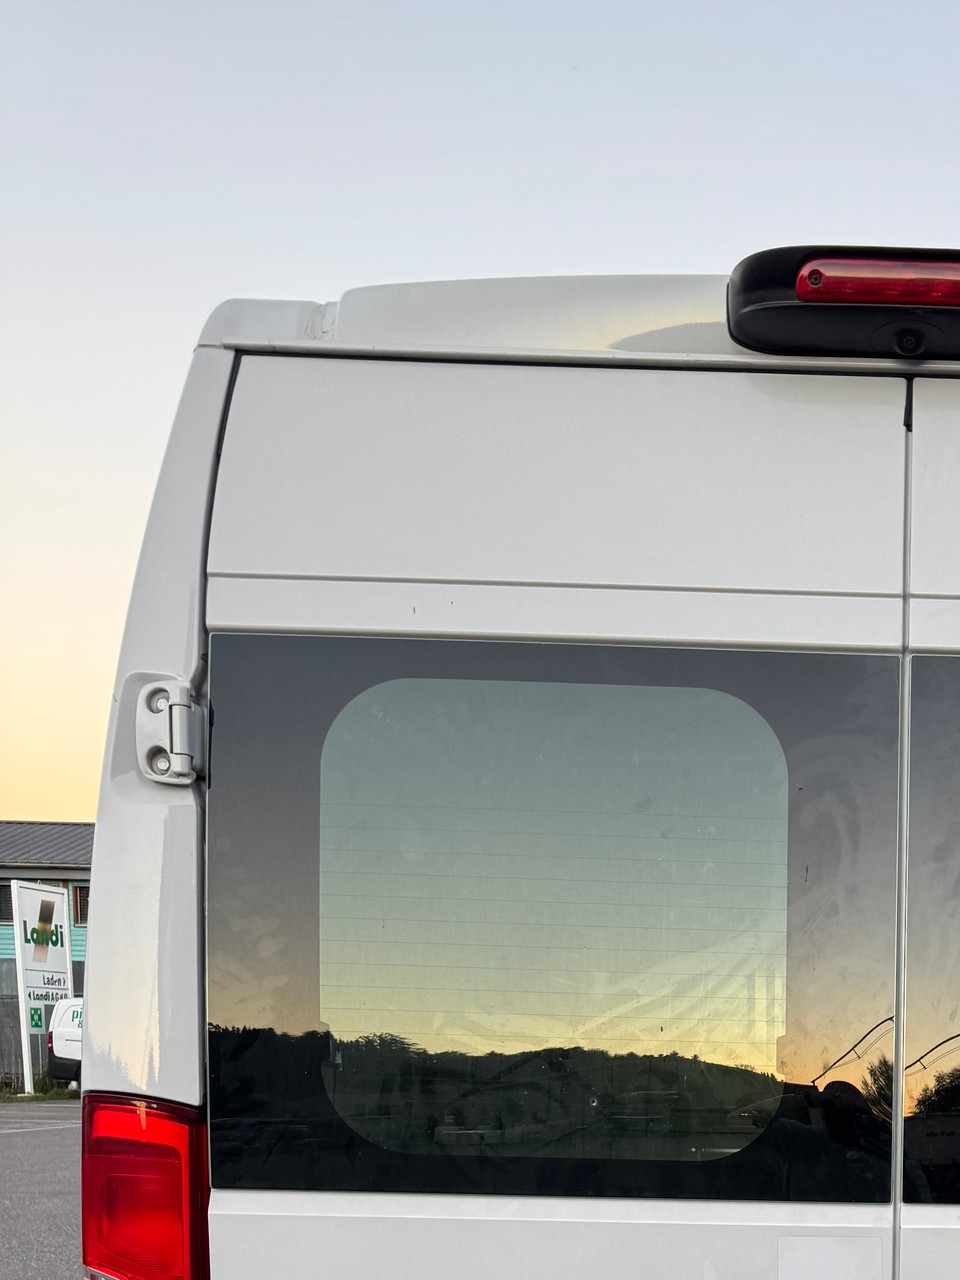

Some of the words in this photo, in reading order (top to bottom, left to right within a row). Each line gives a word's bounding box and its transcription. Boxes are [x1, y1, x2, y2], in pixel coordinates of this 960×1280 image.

[23, 919, 64, 948] Landi
[43, 974, 62, 986] Laden
[33, 990, 50, 1002] Landi
[72, 1007, 83, 1022] pi
